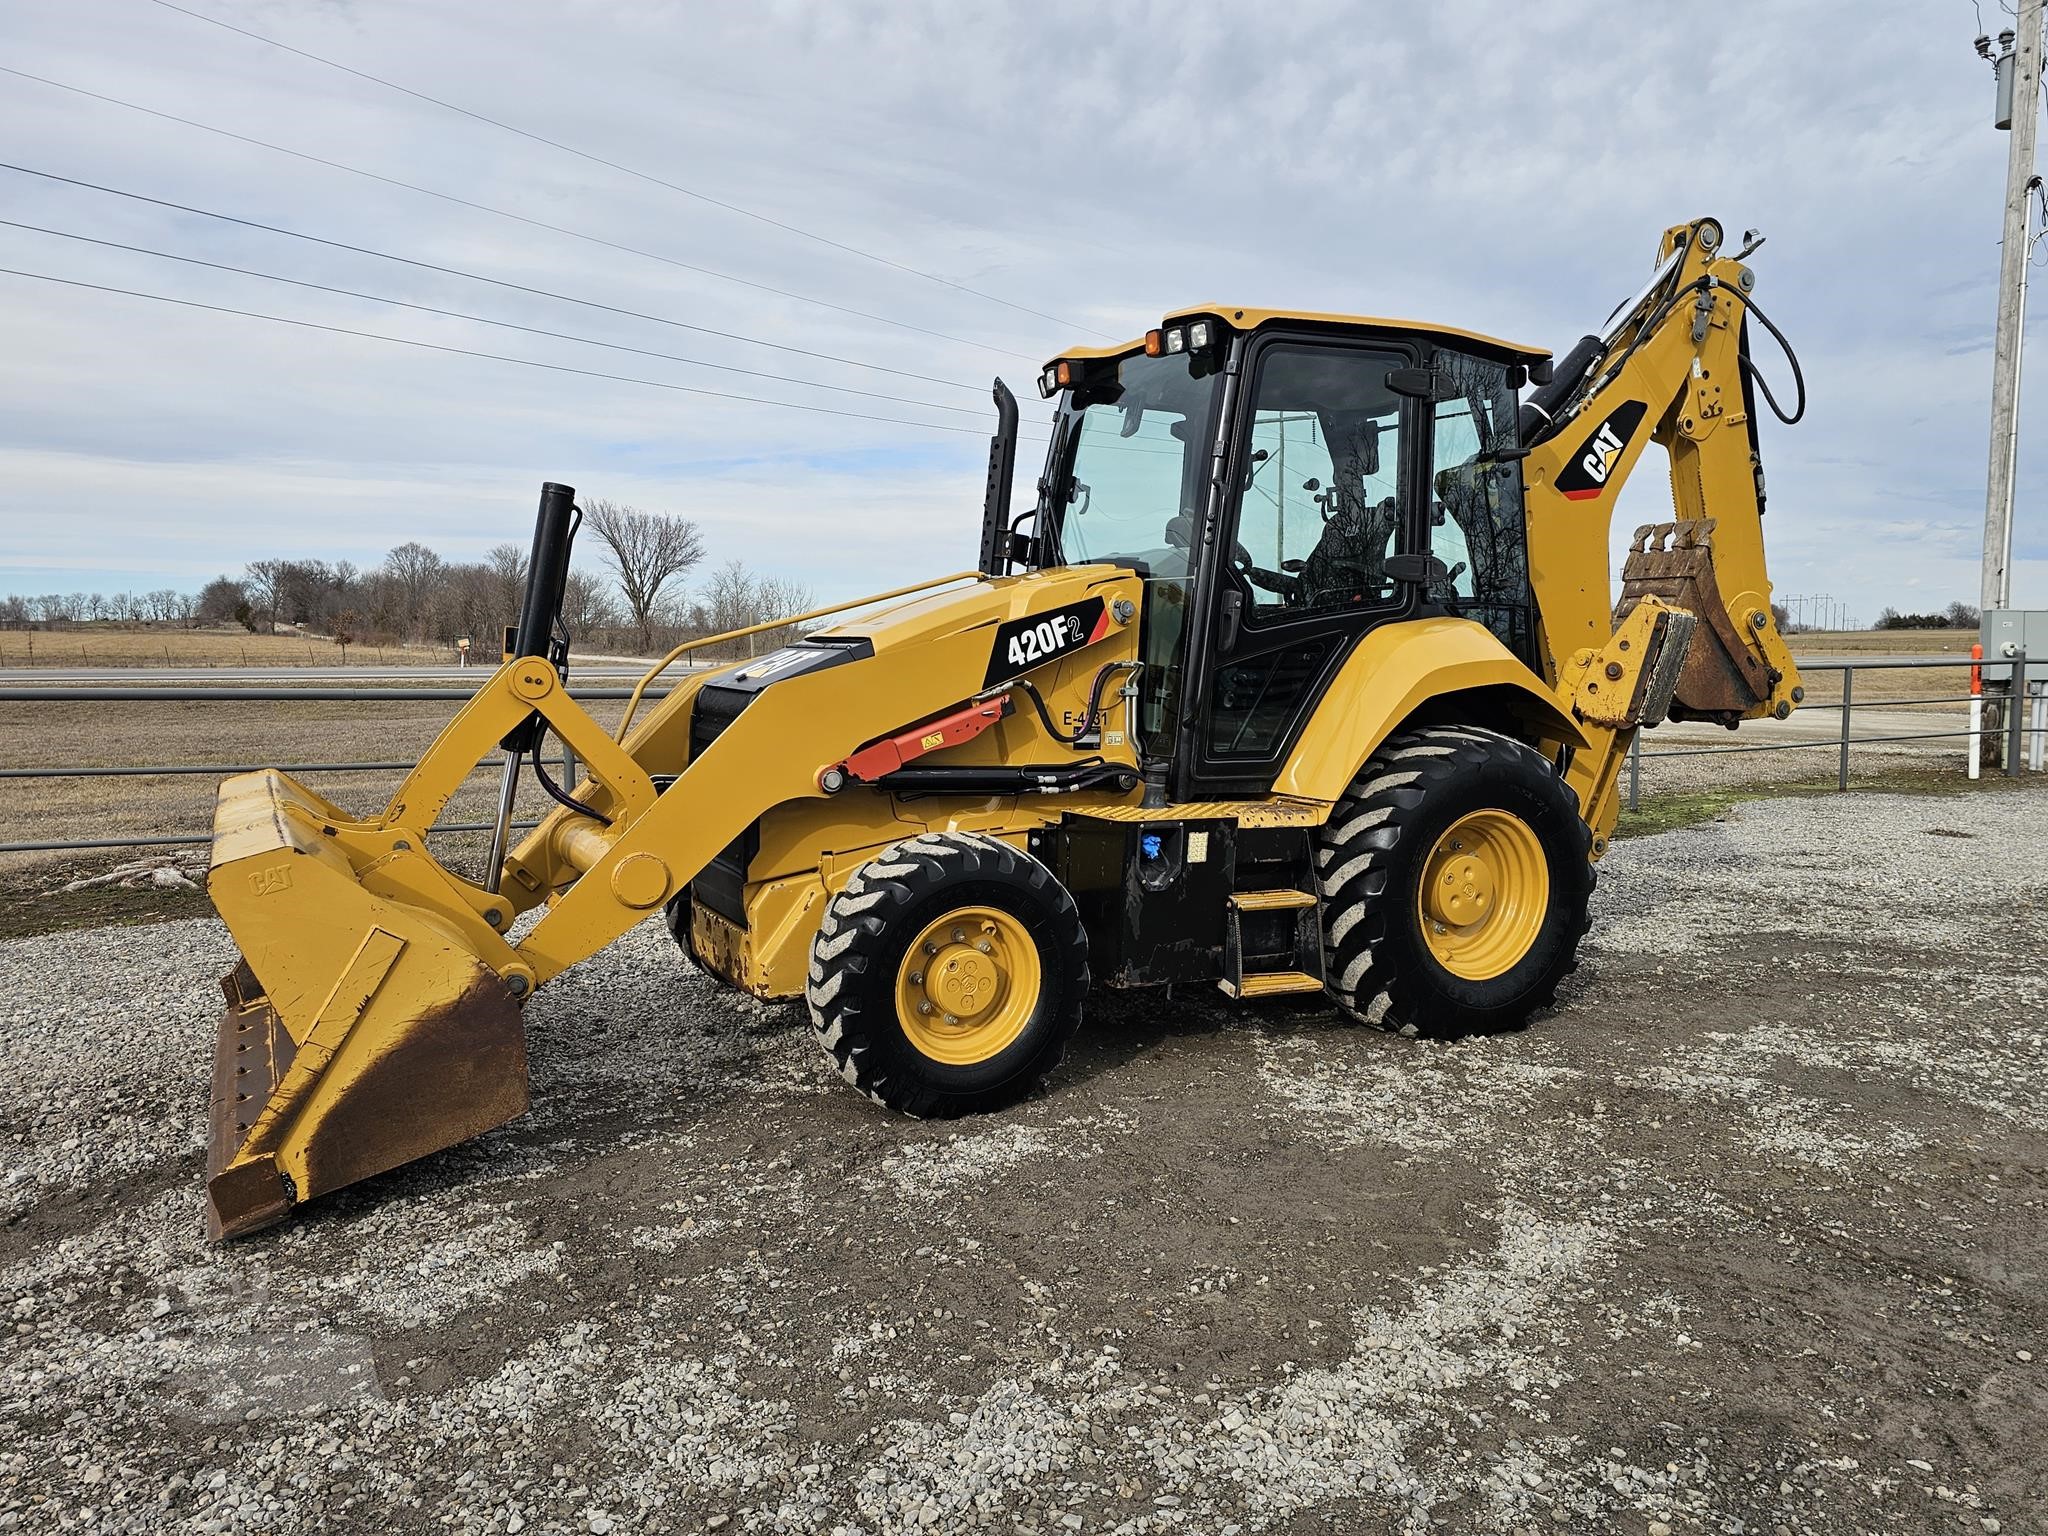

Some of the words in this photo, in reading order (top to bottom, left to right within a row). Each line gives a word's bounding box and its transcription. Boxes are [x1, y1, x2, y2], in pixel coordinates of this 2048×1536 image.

[1583, 421, 1624, 483] CAT
[1064, 711, 1107, 726] E-431
[248, 864, 293, 896] CAT
